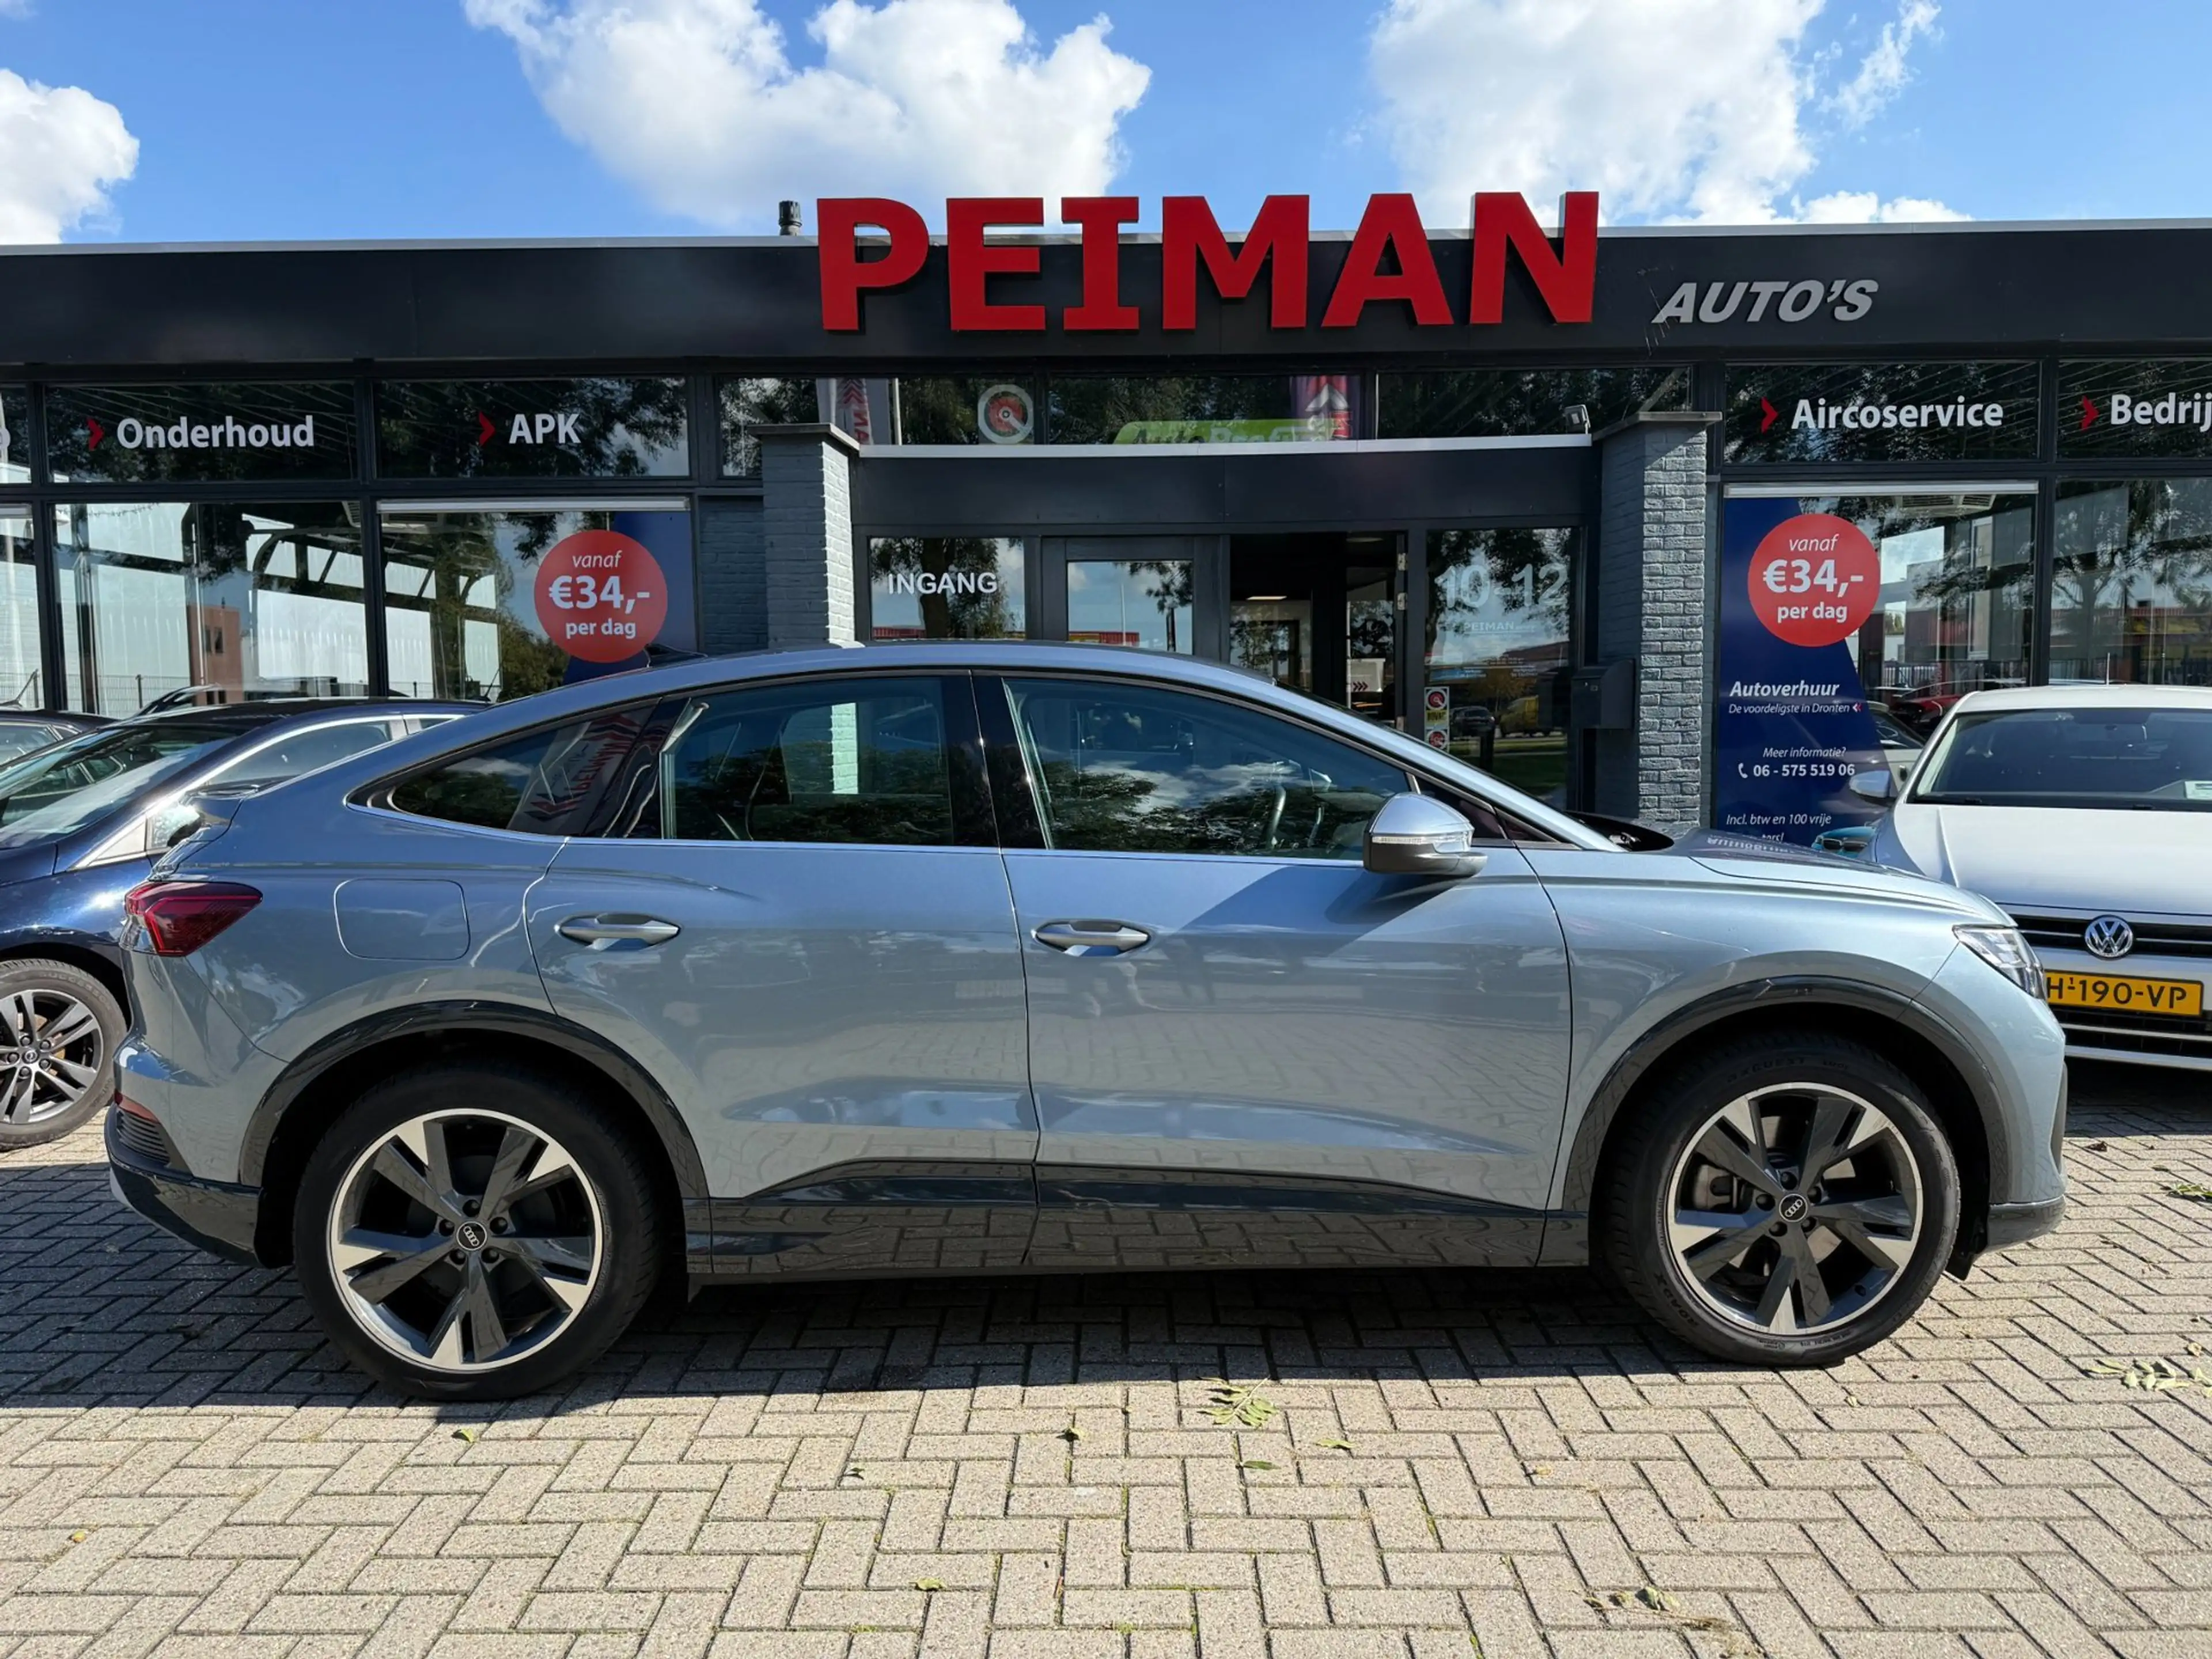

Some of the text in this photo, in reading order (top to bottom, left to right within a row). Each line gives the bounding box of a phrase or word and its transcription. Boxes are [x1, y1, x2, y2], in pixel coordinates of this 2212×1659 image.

[817, 192, 1598, 331] PEIMAN
[1652, 279, 1879, 323] AUTO'S
[1791, 395, 2003, 430] Aircoservice
[2111, 392, 2212, 432] Bedrij
[117, 415, 315, 448] Onderhoud
[509, 413, 581, 444] APK
[1789, 533, 1839, 552] vanaf
[573, 550, 622, 569] vanaf
[888, 572, 998, 595] INGANG
[1763, 559, 1864, 597] €34,-
[549, 575, 651, 614] €34,-
[1777, 601, 1847, 624] per dag
[566, 619, 636, 639] per dag
[1729, 680, 1840, 697] Autoverhuur
[1729, 703, 1850, 715] De voordeligste in Dronten
[1763, 747, 1847, 757] Meer informatie?
[1753, 764, 1770, 777] 06
[1782, 764, 1806, 777] 575
[1810, 764, 1835, 776] 519
[1838, 764, 1855, 776] 06
[1726, 813, 1832, 827] Incl. btw en 100 vrije
